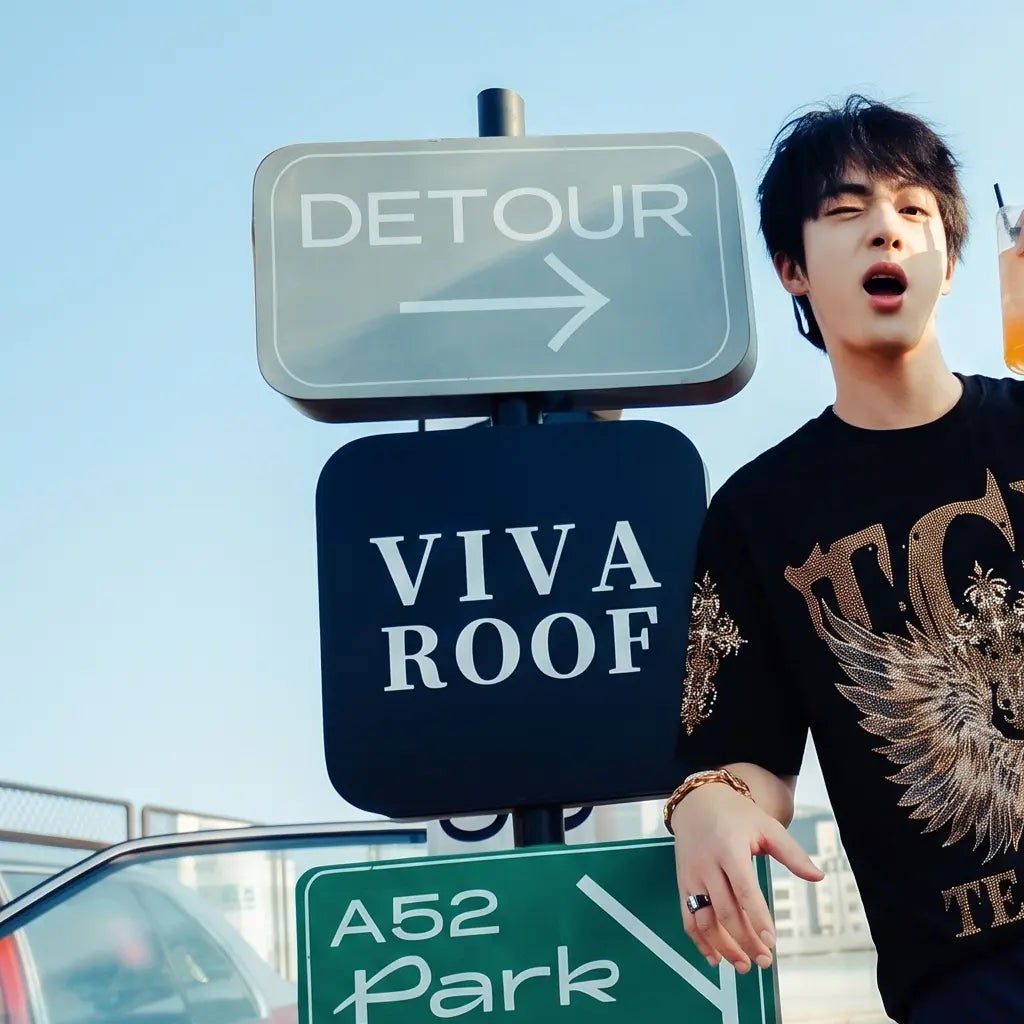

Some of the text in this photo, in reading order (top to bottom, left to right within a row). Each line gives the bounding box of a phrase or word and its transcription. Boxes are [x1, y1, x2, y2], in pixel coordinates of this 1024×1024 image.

[300, 183, 692, 248] DETOUR
[369, 520, 661, 606] VIVA
[381, 606, 658, 692] ROOF
[330, 889, 500, 947] A52
